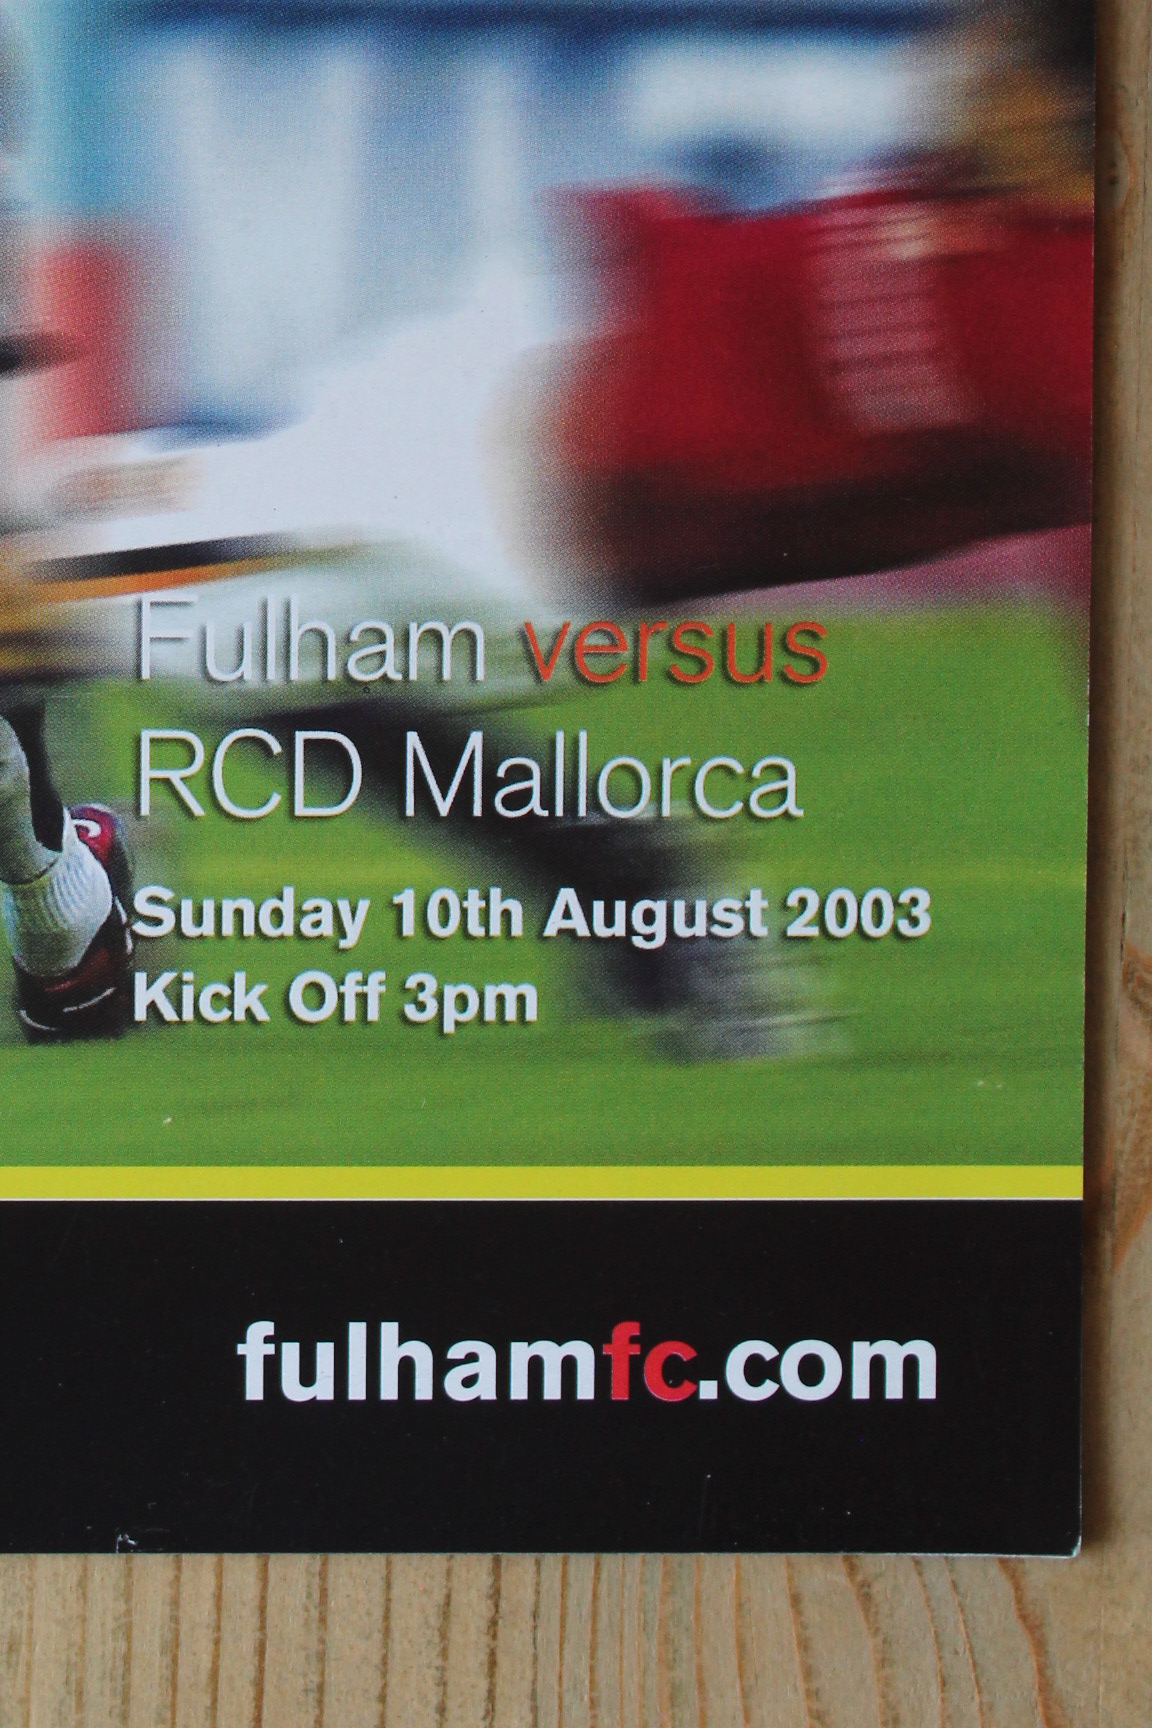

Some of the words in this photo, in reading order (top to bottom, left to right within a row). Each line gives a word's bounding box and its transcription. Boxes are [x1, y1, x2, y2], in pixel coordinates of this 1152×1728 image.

[140, 592, 485, 683] Fulham
[523, 619, 828, 683] versus
[139, 728, 363, 820] RCD
[405, 729, 805, 819] Mallorca
[132, 884, 370, 950] Sunday
[392, 885, 523, 937] 10th
[543, 887, 769, 950] August
[786, 886, 931, 938] 2003
[134, 970, 270, 1022] Kick
[289, 969, 386, 1023] Off
[404, 971, 538, 1034] 3pm
[236, 1320, 937, 1403] fulhamfc.com
